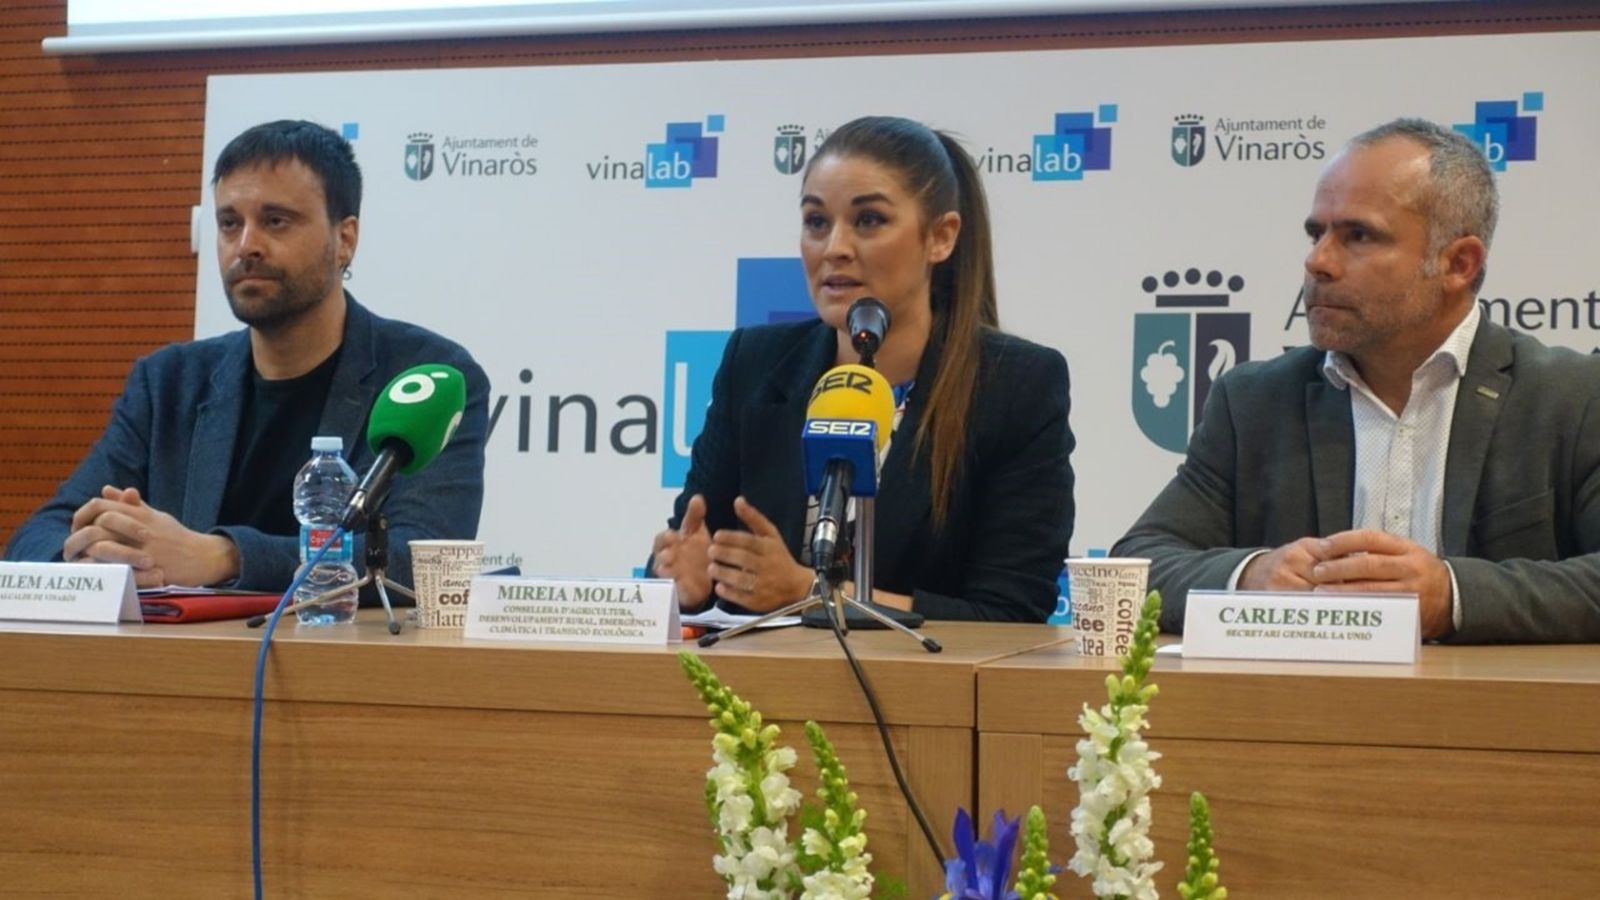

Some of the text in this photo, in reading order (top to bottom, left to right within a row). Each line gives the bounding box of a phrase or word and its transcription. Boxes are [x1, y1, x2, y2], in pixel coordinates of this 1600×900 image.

[1215, 115, 1325, 134] Ajuntament de
[442, 134, 538, 151] Ajuntament de
[1214, 133, 1325, 161] Vinaròs
[442, 151, 538, 177] Vinaròs
[586, 152, 692, 181] vinalab
[807, 420, 872, 436] SER
[44, 576, 104, 591] ALSINA
[498, 583, 644, 604] MIREIA MOLLÀ
[436, 609, 466, 627] latt
[479, 614, 564, 625] DESENVOLUPAMENT
[503, 605, 560, 615] CONSELLERA
[1219, 606, 1383, 627] CARLES PERIS
[1115, 598, 1134, 655] coffee
[1226, 628, 1373, 641] SECRETARI GENERAL LA UNIÓ
[1082, 635, 1105, 656] tea
